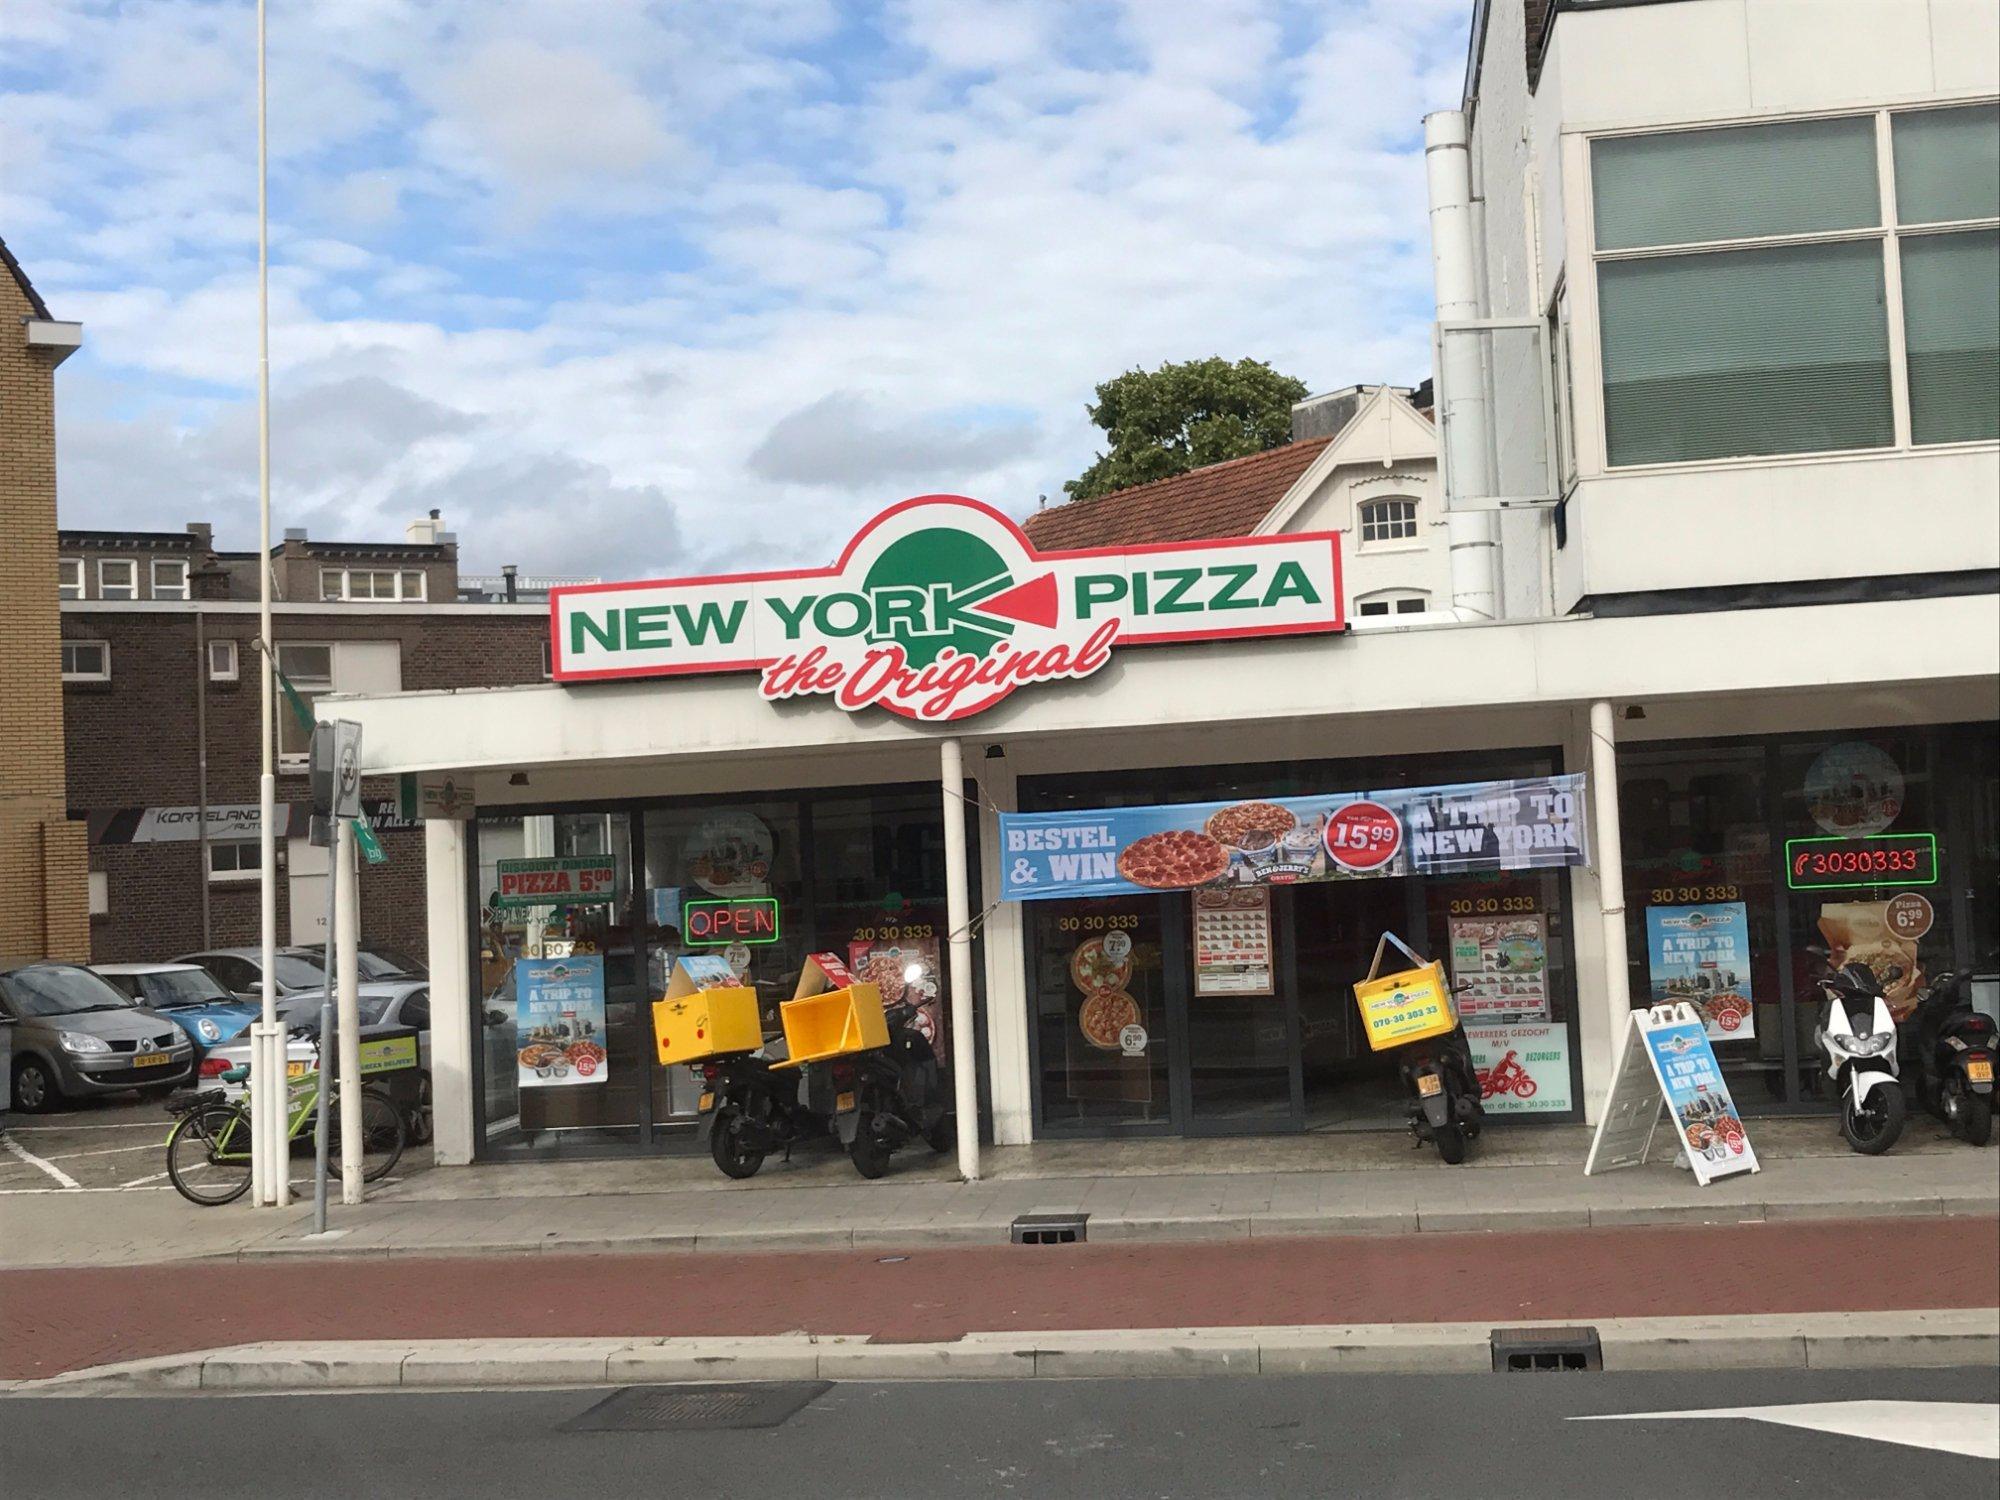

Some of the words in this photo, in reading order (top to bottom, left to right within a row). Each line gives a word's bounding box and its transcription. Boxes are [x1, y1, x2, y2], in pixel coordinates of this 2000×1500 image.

[570, 600, 749, 655] NEW
[764, 574, 1015, 640] YORK
[1074, 560, 1322, 620] PIZZA
[762, 645, 847, 697] the
[840, 617, 1121, 718] Original
[1413, 804, 1434, 828] A
[1442, 797, 1521, 825] TRIP
[1530, 792, 1575, 820] TO
[1007, 825, 1117, 852] BESTEL
[1334, 822, 1395, 850] 15.99
[1413, 828, 1484, 855] NEW
[1495, 822, 1577, 849] YORK
[501, 861, 559, 873] DISCOUNT
[1009, 857, 1039, 884] &
[1048, 851, 1117, 882] WIN
[1813, 850, 1917, 874] 3030333
[502, 871, 572, 895] PIZZA
[1652, 889, 1674, 902] 30
[1678, 887, 1701, 901] 30
[1705, 886, 1739, 900] 333
[1450, 900, 1472, 914] 30
[1476, 899, 1499, 912] 30
[1503, 896, 1535, 911] 333
[689, 909, 774, 936] OPEN
[1059, 917, 1080, 931] 30
[1083, 916, 1105, 930] 30
[1108, 915, 1139, 928] 333
[1896, 910, 1924, 927] 6.99
[855, 928, 875, 941] 30
[879, 927, 899, 939] 30
[903, 925, 933, 938] 333
[1662, 939, 1673, 951] A
[1676, 937, 1711, 950] TRIP
[1714, 935, 1735, 948] TO
[1662, 951, 1695, 965] NEW
[1698, 949, 1737, 962] YORK
[529, 989, 539, 1001] A
[541, 987, 571, 1000] TRIP
[574, 986, 593, 999] TO
[529, 1000, 560, 1014] NEW
[560, 999, 593, 1013] YORK
[1373, 1013, 1406, 1029] 070-30
[1406, 1008, 1425, 1020] 303
[1425, 1005, 1439, 1015] 33
[1510, 1028, 1550, 1037] GEZOCHT
[1525, 1051, 1561, 1062] BEZORGERS
[1673, 1059, 1697, 1075] TRIP
[1696, 1057, 1711, 1071] TO
[1497, 1101, 1506, 1109] of
[1527, 1100, 1538, 1108] 30
[1539, 1100, 1550, 1108] 30
[1551, 1099, 1566, 1107] 333
